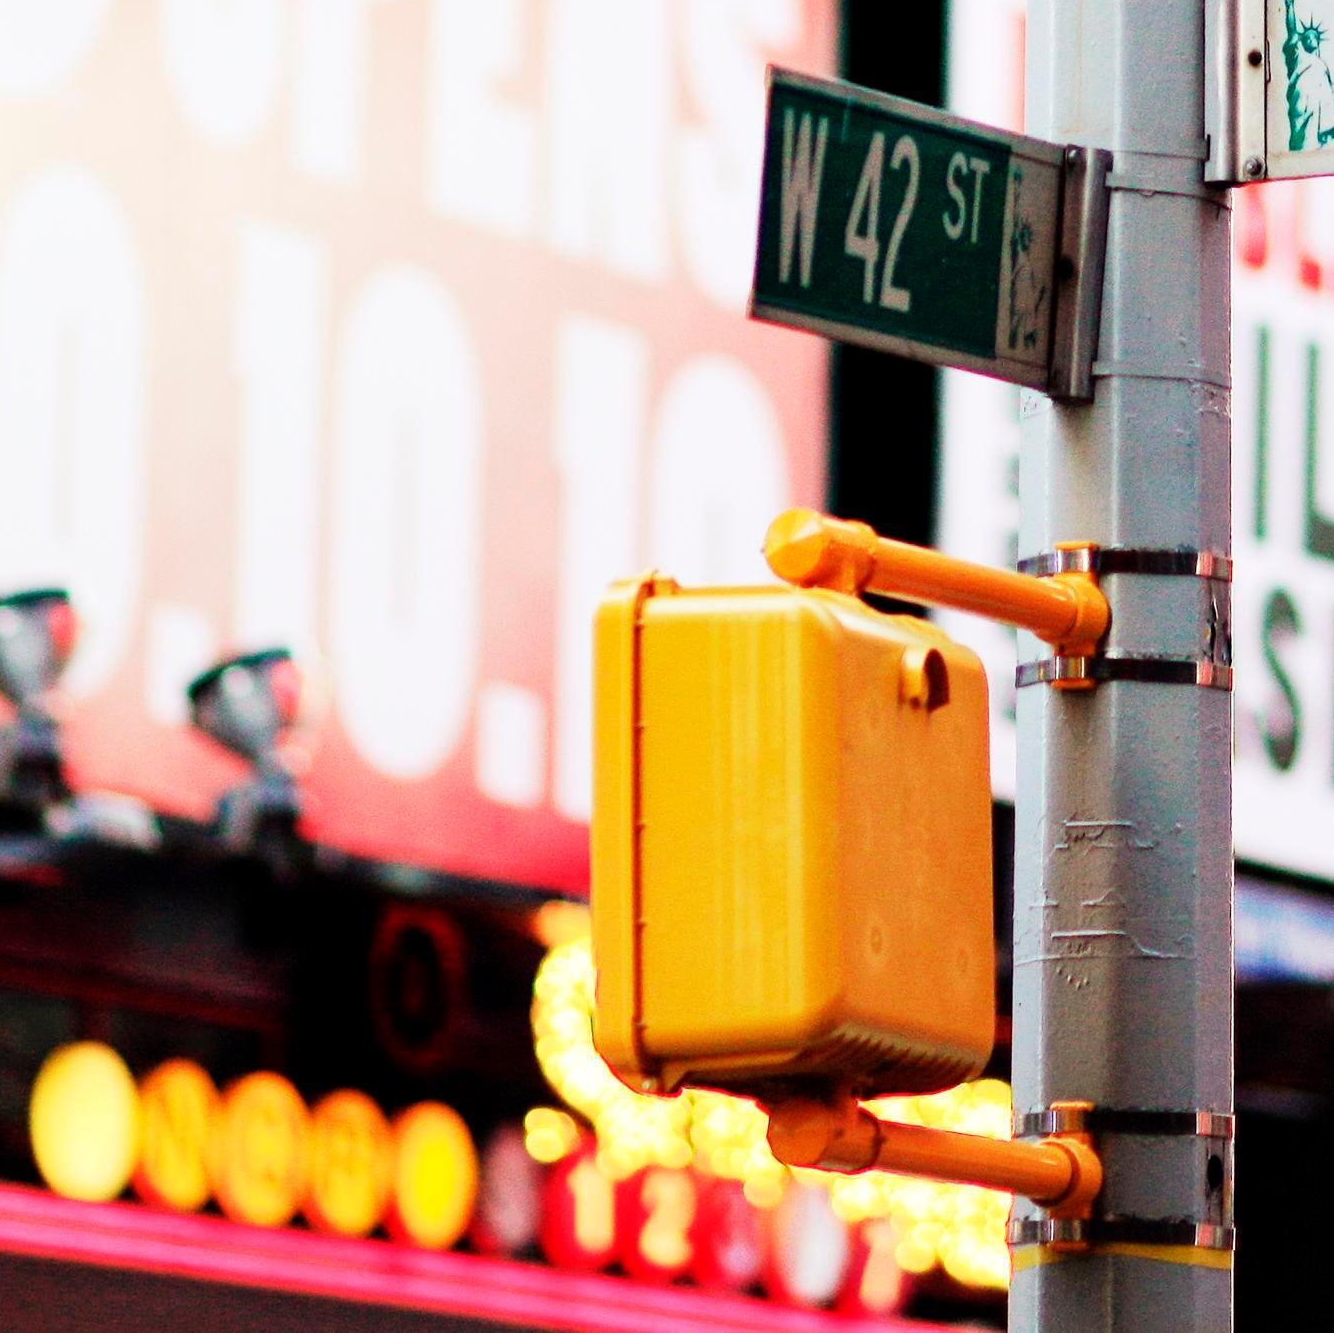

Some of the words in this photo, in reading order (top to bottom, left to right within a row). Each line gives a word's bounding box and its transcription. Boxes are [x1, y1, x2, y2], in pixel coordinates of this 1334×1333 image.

[778, 106, 830, 290] W
[843, 130, 921, 313] 42
[942, 151, 991, 245] ST
